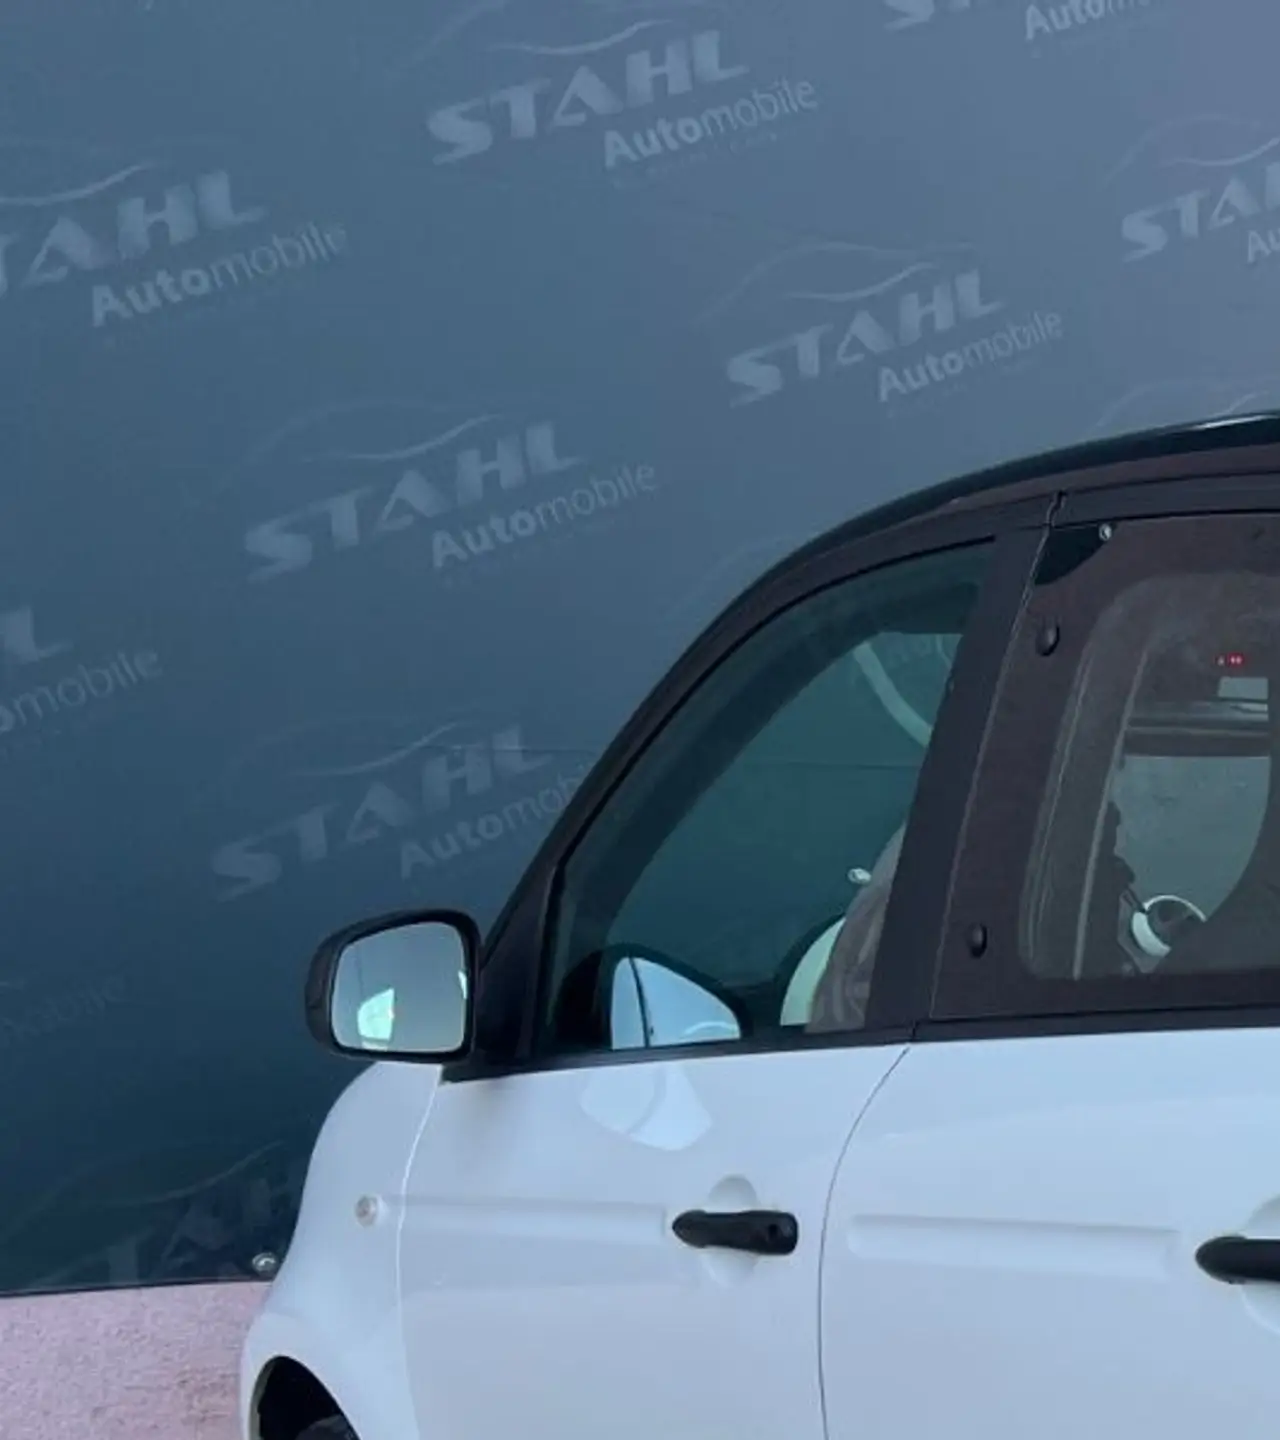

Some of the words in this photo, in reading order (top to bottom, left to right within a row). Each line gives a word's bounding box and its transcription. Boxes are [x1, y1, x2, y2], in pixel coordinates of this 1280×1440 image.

[425, 29, 750, 166] STAHL
[602, 76, 822, 171] Automobile
[0, 168, 272, 302] TAHL
[90, 218, 350, 328] Automobile
[724, 267, 1006, 409] STAHL
[876, 308, 1064, 403] Automobile
[242, 420, 590, 584] STAHL
[431, 461, 658, 570] Automobile
[0, 647, 164, 735] omobile
[210, 723, 556, 904] STAHL
